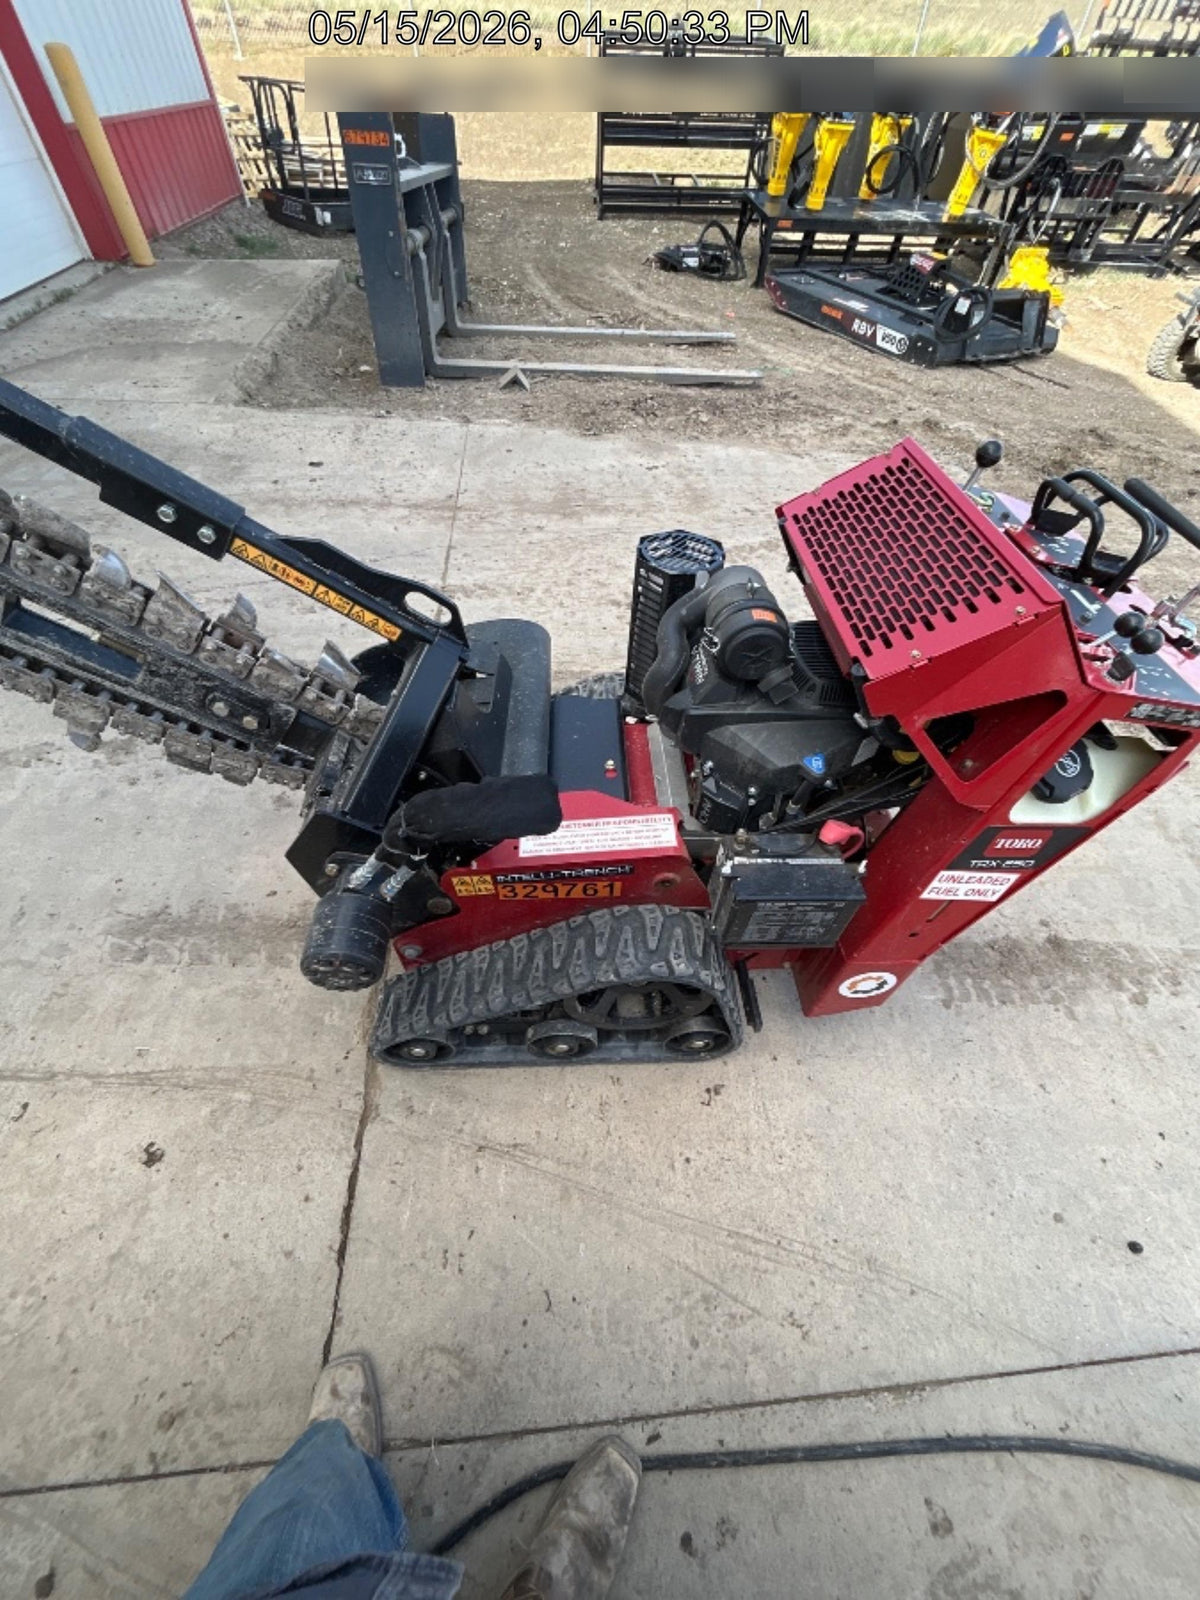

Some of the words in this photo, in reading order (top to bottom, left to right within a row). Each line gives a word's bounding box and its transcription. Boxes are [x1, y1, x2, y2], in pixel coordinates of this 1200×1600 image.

[994, 838, 1042, 849] TORO
[497, 866, 631, 882] INTELLI-TRENCH
[937, 874, 1011, 886] UNLEADED
[502, 882, 615, 898] 329761
[927, 887, 960, 897] FUEL
[963, 889, 1002, 898] ONLY
